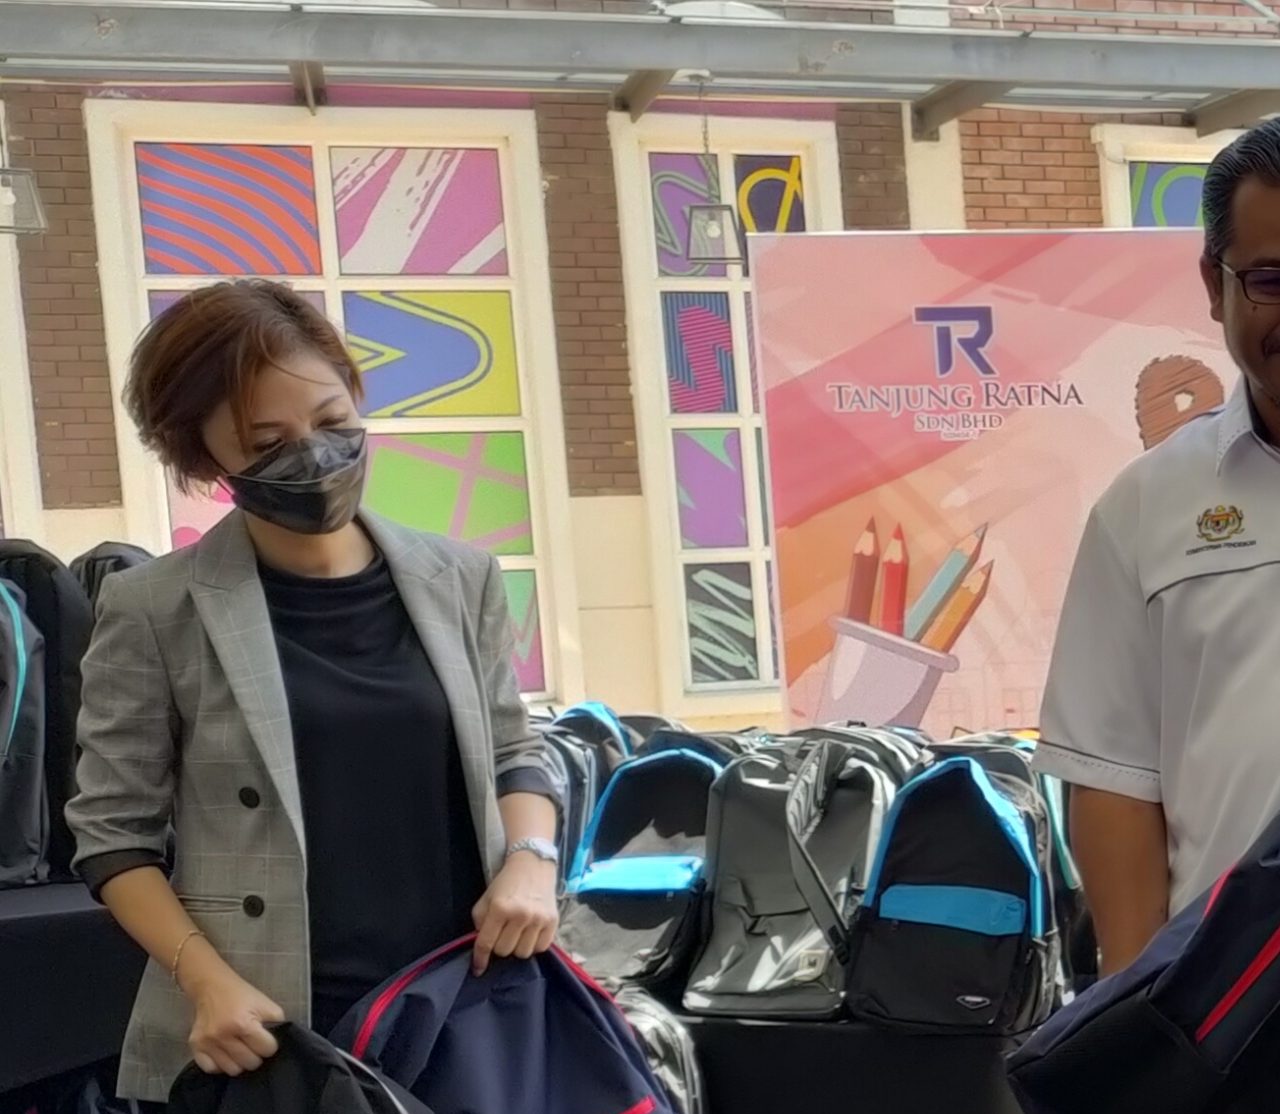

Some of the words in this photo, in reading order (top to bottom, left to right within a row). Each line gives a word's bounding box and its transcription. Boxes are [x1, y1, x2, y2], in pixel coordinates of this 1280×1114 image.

[914, 306, 996, 376] TR
[829, 384, 973, 416] TANJUNG
[982, 382, 1084, 408] RATNA
[915, 415, 955, 430] SDN
[960, 413, 1003, 429] BHD
